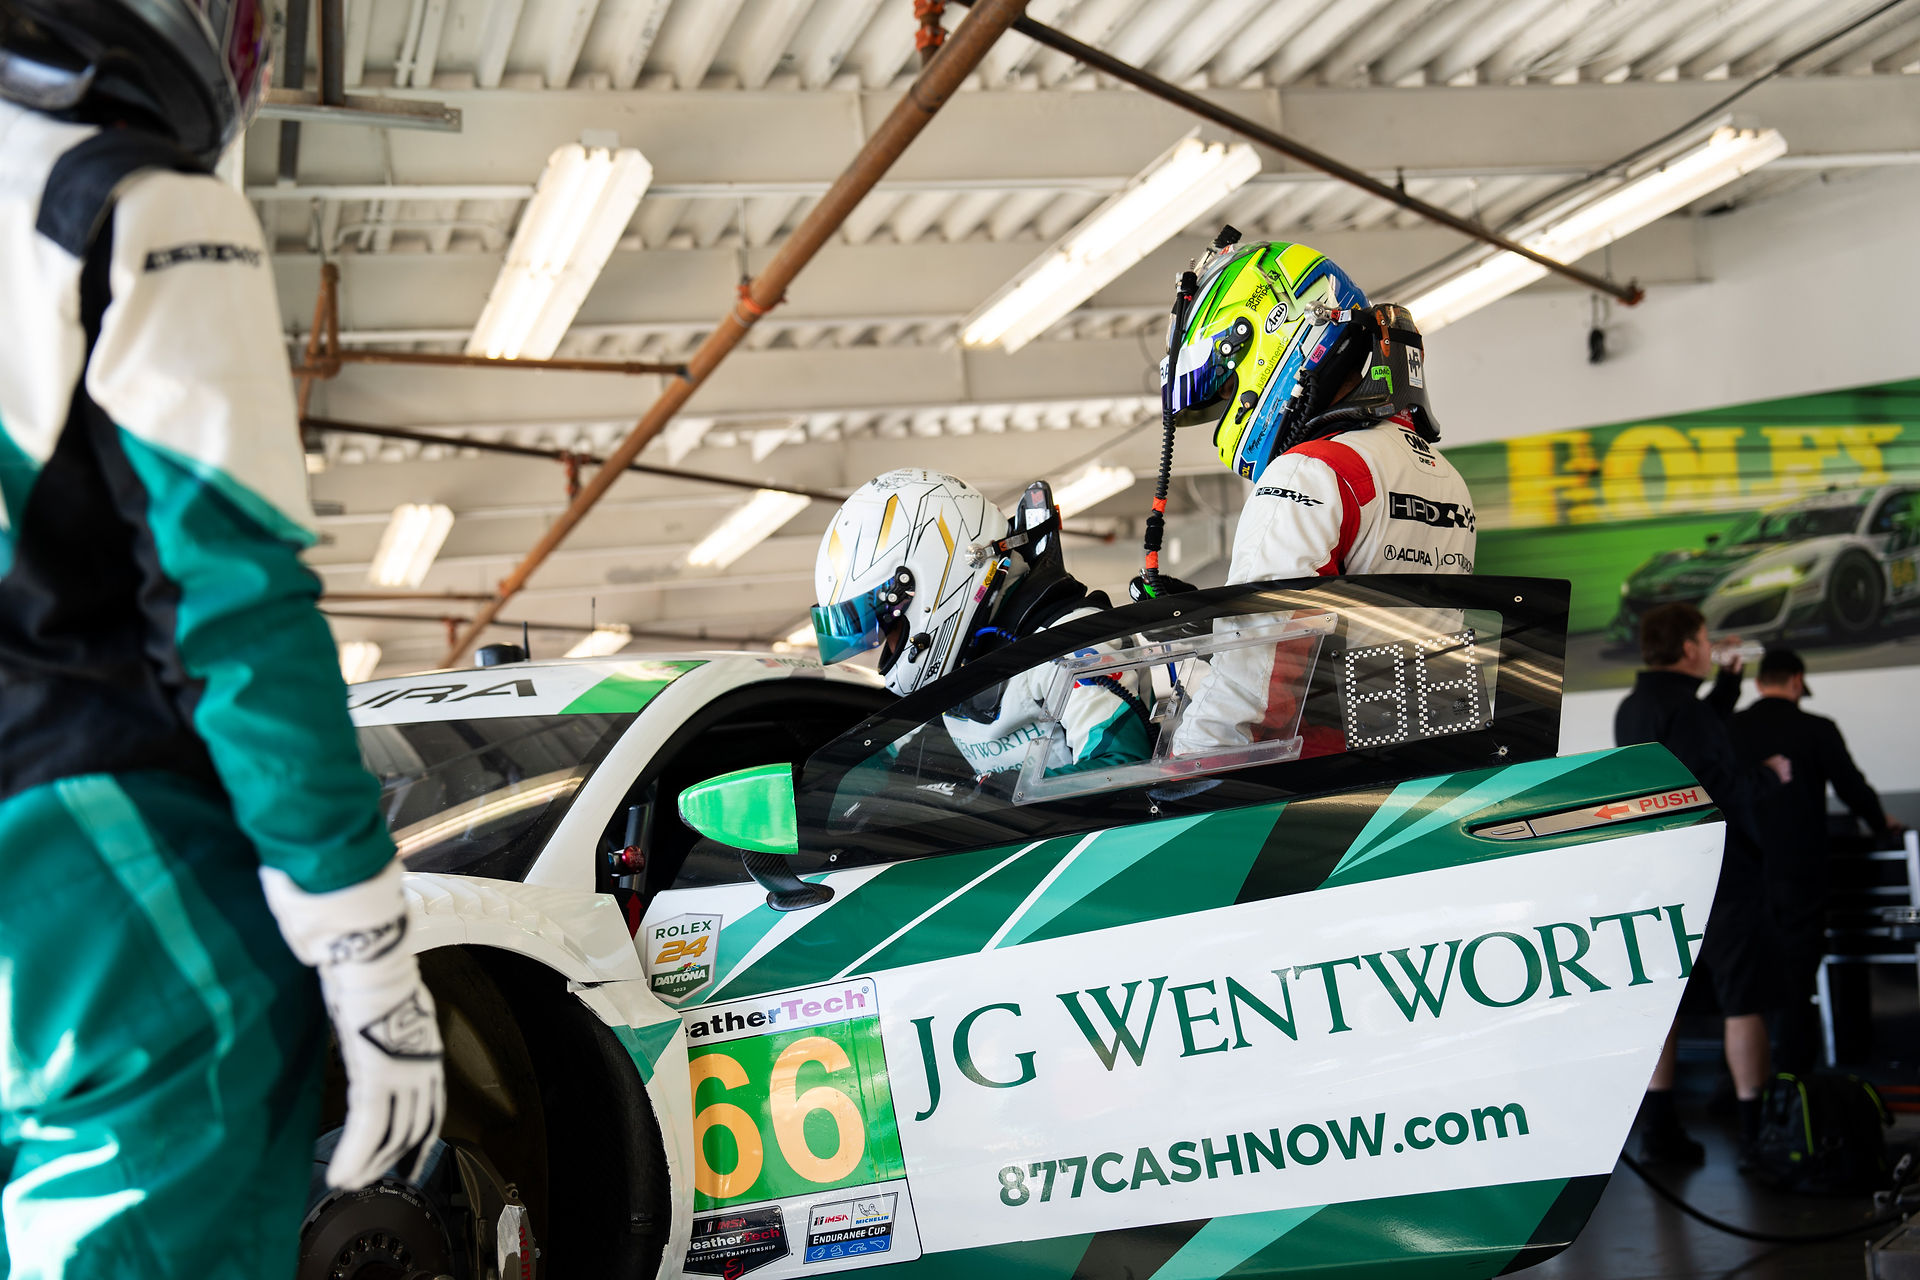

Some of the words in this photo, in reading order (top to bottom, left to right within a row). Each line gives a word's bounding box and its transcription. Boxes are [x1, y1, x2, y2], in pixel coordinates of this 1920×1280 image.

[1268, 304, 1286, 331] Arai
[1391, 495, 1440, 523] HPD
[1396, 547, 1433, 567] ACURA
[1638, 789, 1699, 812] PUSH
[655, 919, 712, 940] ROLEX
[655, 935, 709, 965] 24
[654, 969, 706, 987] DAYTONA
[910, 1003, 1037, 1122] JG
[688, 1036, 866, 1199] 66
[998, 1102, 1530, 1208] 877CASHNOW.com
[717, 1217, 748, 1231] IMSA
[825, 1214, 849, 1224] IMSA
[855, 1215, 890, 1225] MICHELIN
[688, 1227, 780, 1251] eatherTech
[812, 1229, 866, 1245] ENDURANCE
